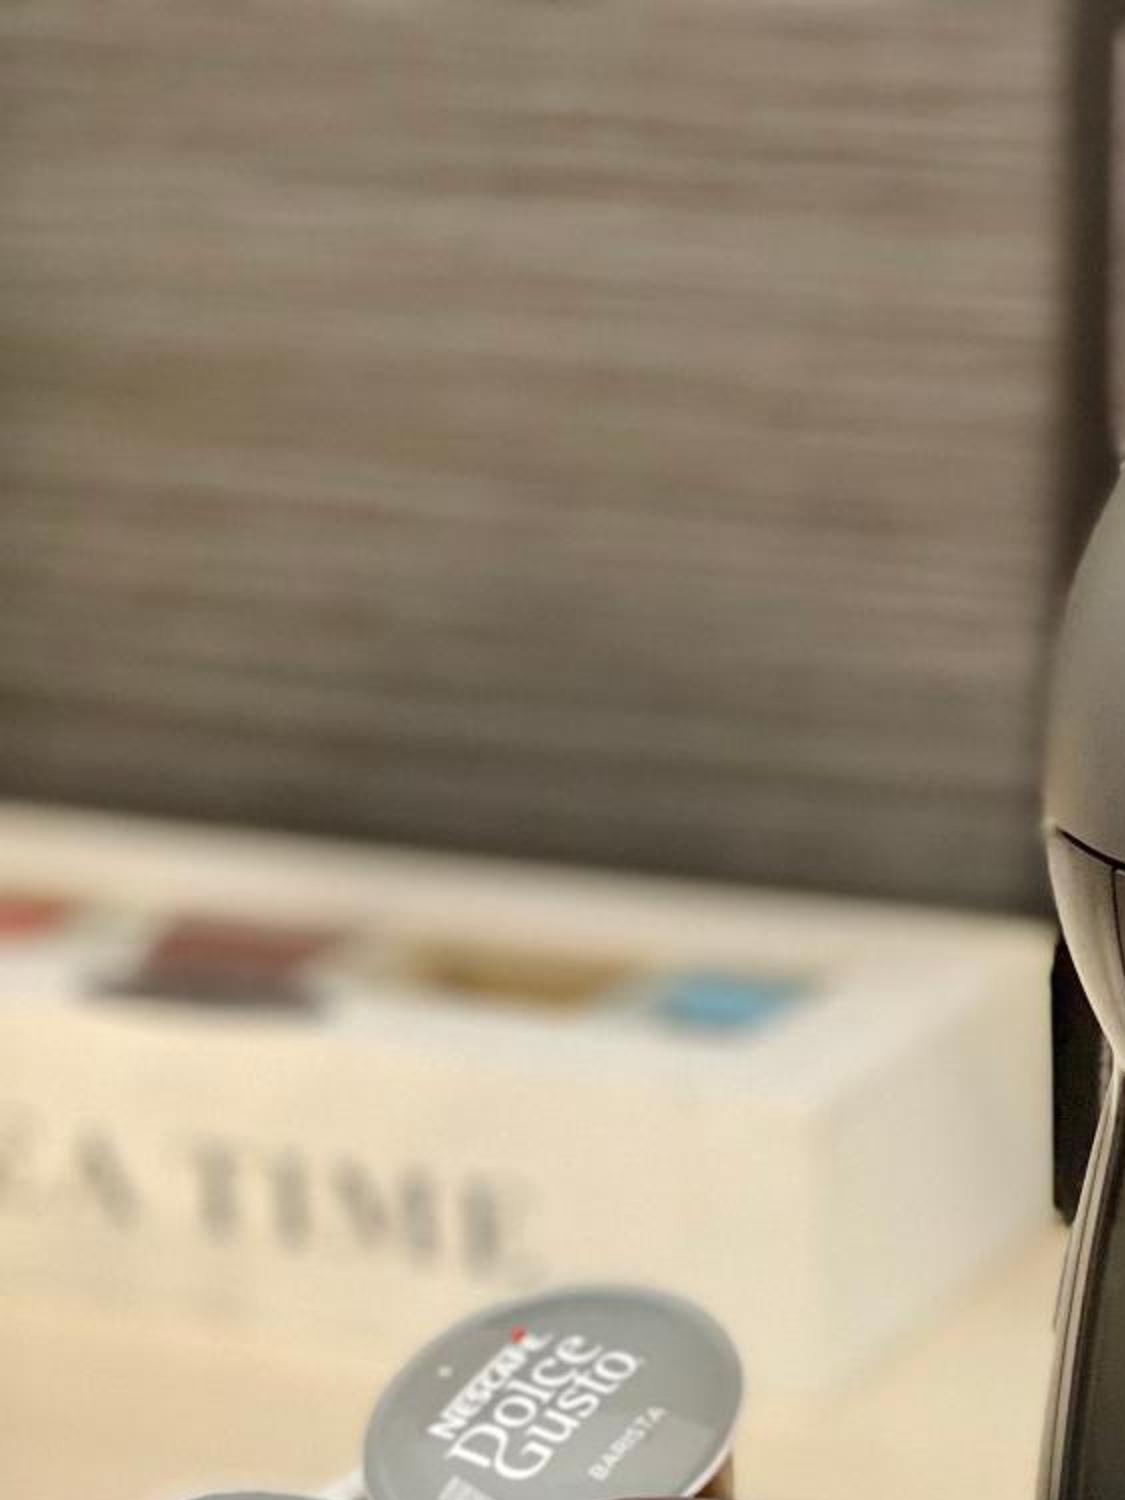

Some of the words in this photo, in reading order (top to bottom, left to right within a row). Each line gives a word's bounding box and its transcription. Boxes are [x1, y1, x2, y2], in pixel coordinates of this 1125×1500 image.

[444, 1335, 603, 1468] Dolce
[494, 1350, 638, 1480] Gusto
[588, 1405, 667, 1482] BARISTA
